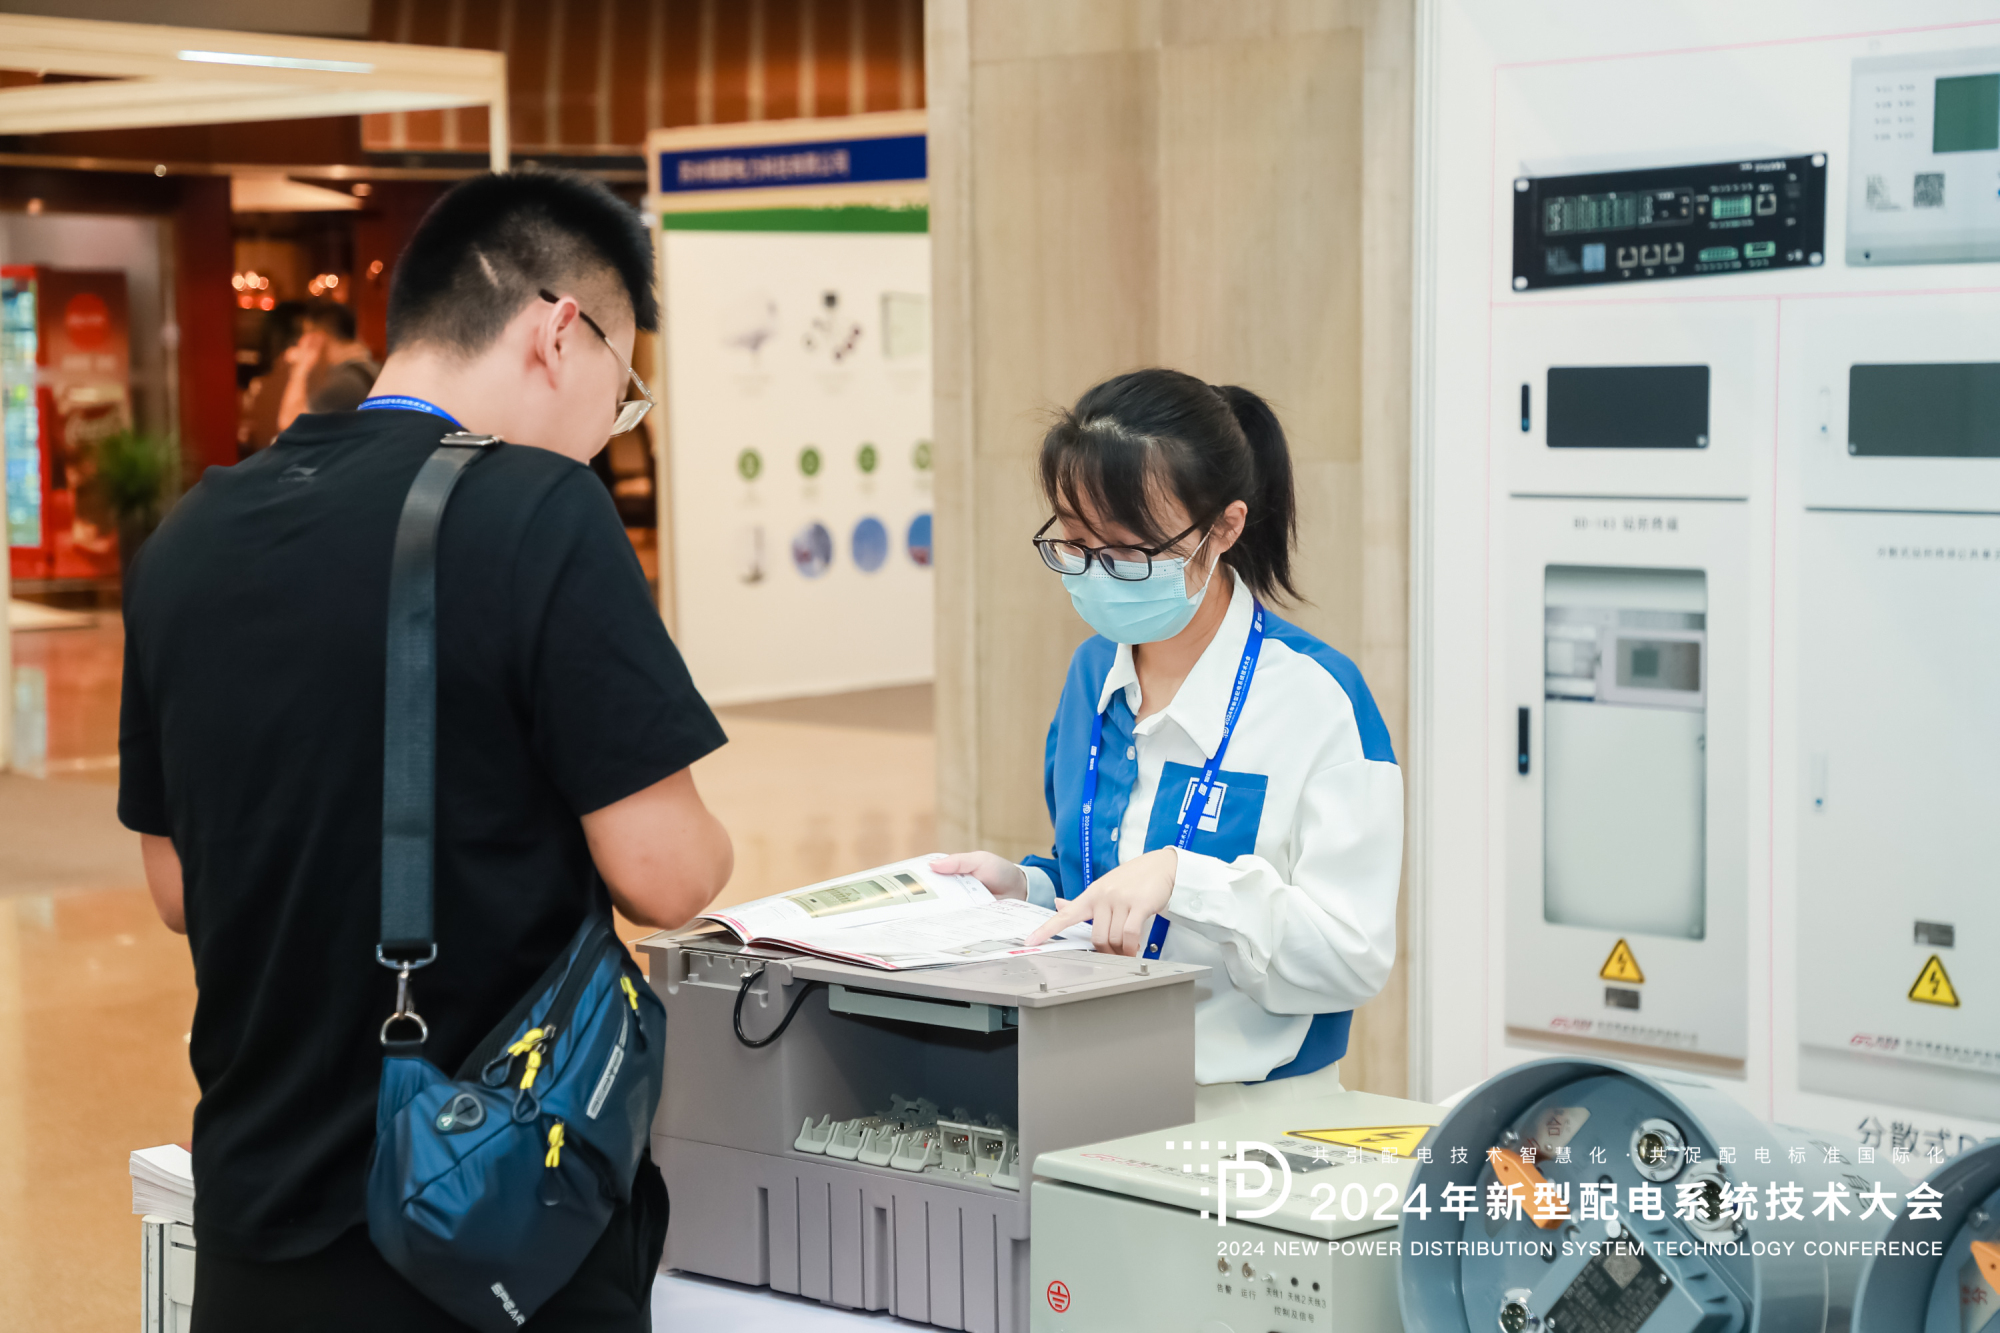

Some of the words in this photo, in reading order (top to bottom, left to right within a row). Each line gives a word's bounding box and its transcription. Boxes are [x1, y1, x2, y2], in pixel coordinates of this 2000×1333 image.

[1241, 1289, 1256, 1300] 运行
[1266, 1287, 1283, 1299] 天线1
[1287, 1292, 1306, 1304] 天线2
[1274, 1306, 1315, 1323] 控制及信号
